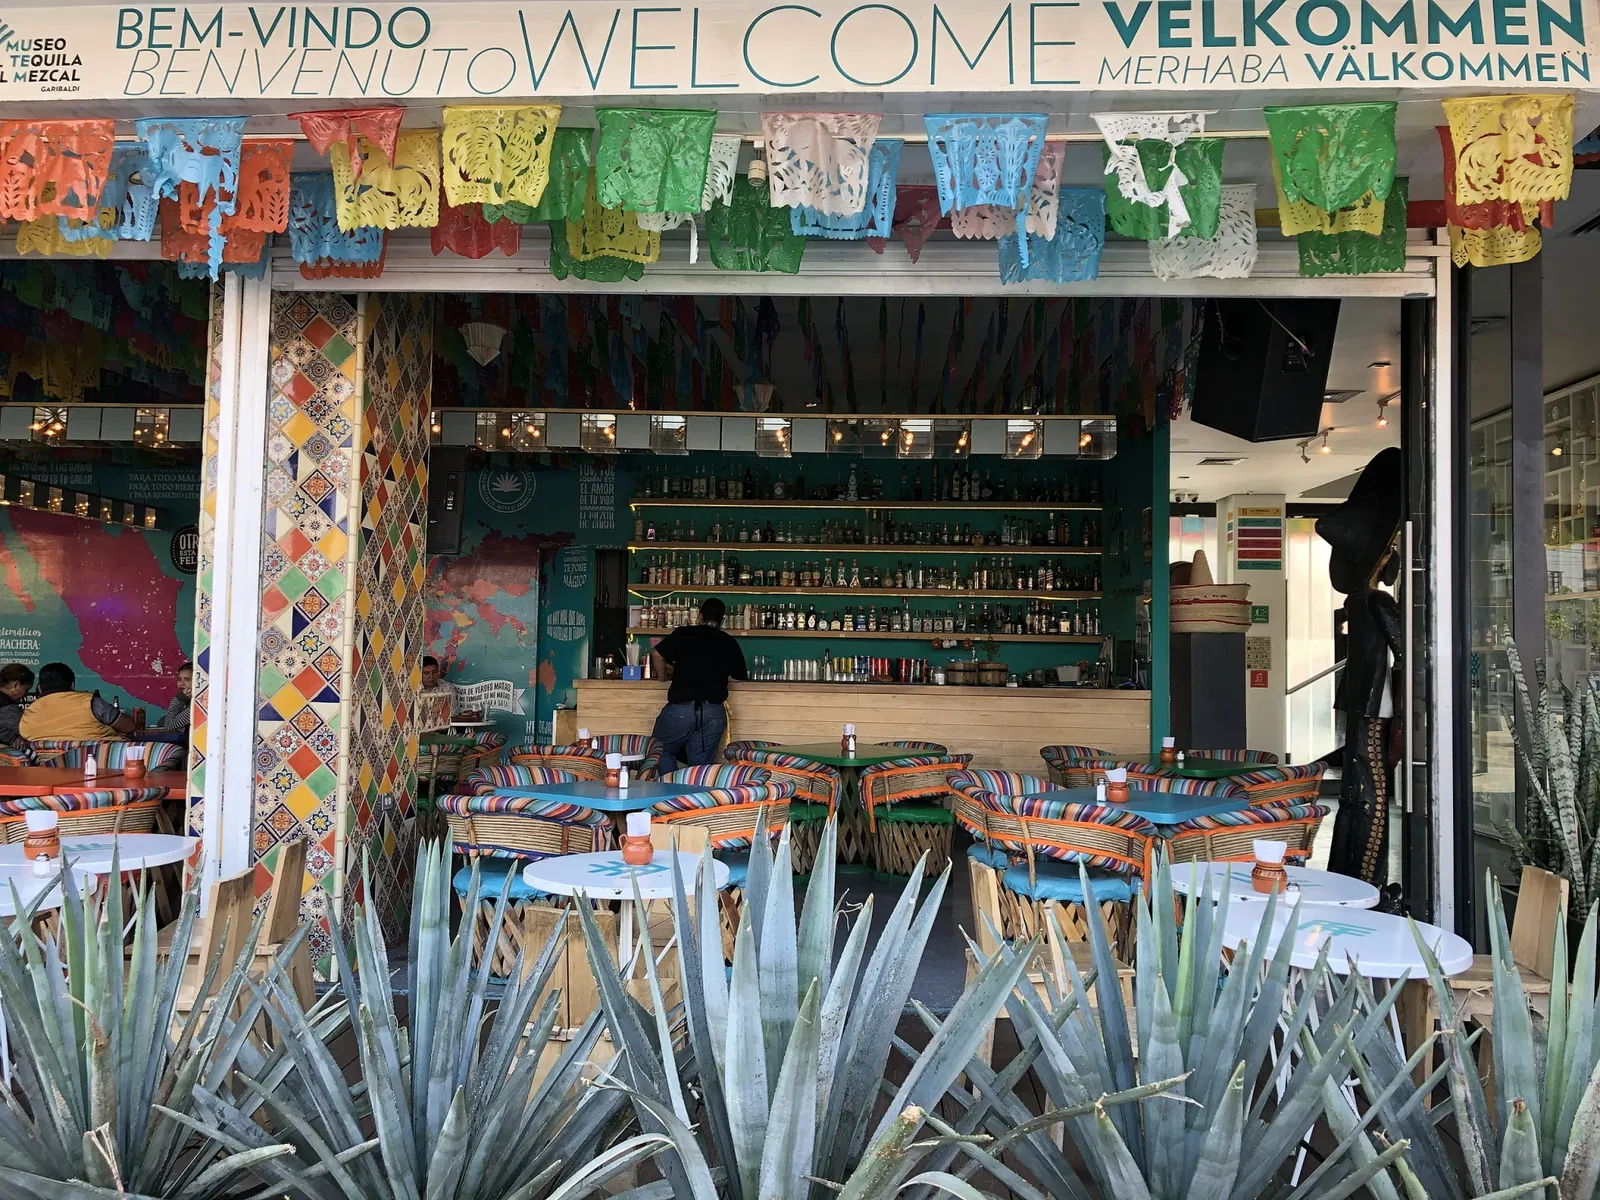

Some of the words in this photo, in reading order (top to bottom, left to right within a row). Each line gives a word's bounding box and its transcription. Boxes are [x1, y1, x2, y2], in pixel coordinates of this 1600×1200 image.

[116, 6, 431, 49] BEM-VINDO
[1111, 0, 1586, 49] VELKOMMEN
[6, 38, 66, 52] MUSEO
[519, 2, 1082, 92] WELCOME
[10, 54, 82, 67] TEQUILA
[1305, 45, 1591, 83] VÄLKOMMEN
[13, 69, 80, 82] MEZCAL
[122, 47, 516, 97] BENVENUTO
[1099, 53, 1290, 84] MERHABA
[128, 474, 151, 482] PARA
[153, 474, 176, 482] TODO
[178, 474, 196, 482] MAL
[128, 483, 150, 491] PARA
[580, 484, 589, 495] EL
[591, 484, 615, 495] AMOR
[600, 495, 615, 505] VIDA
